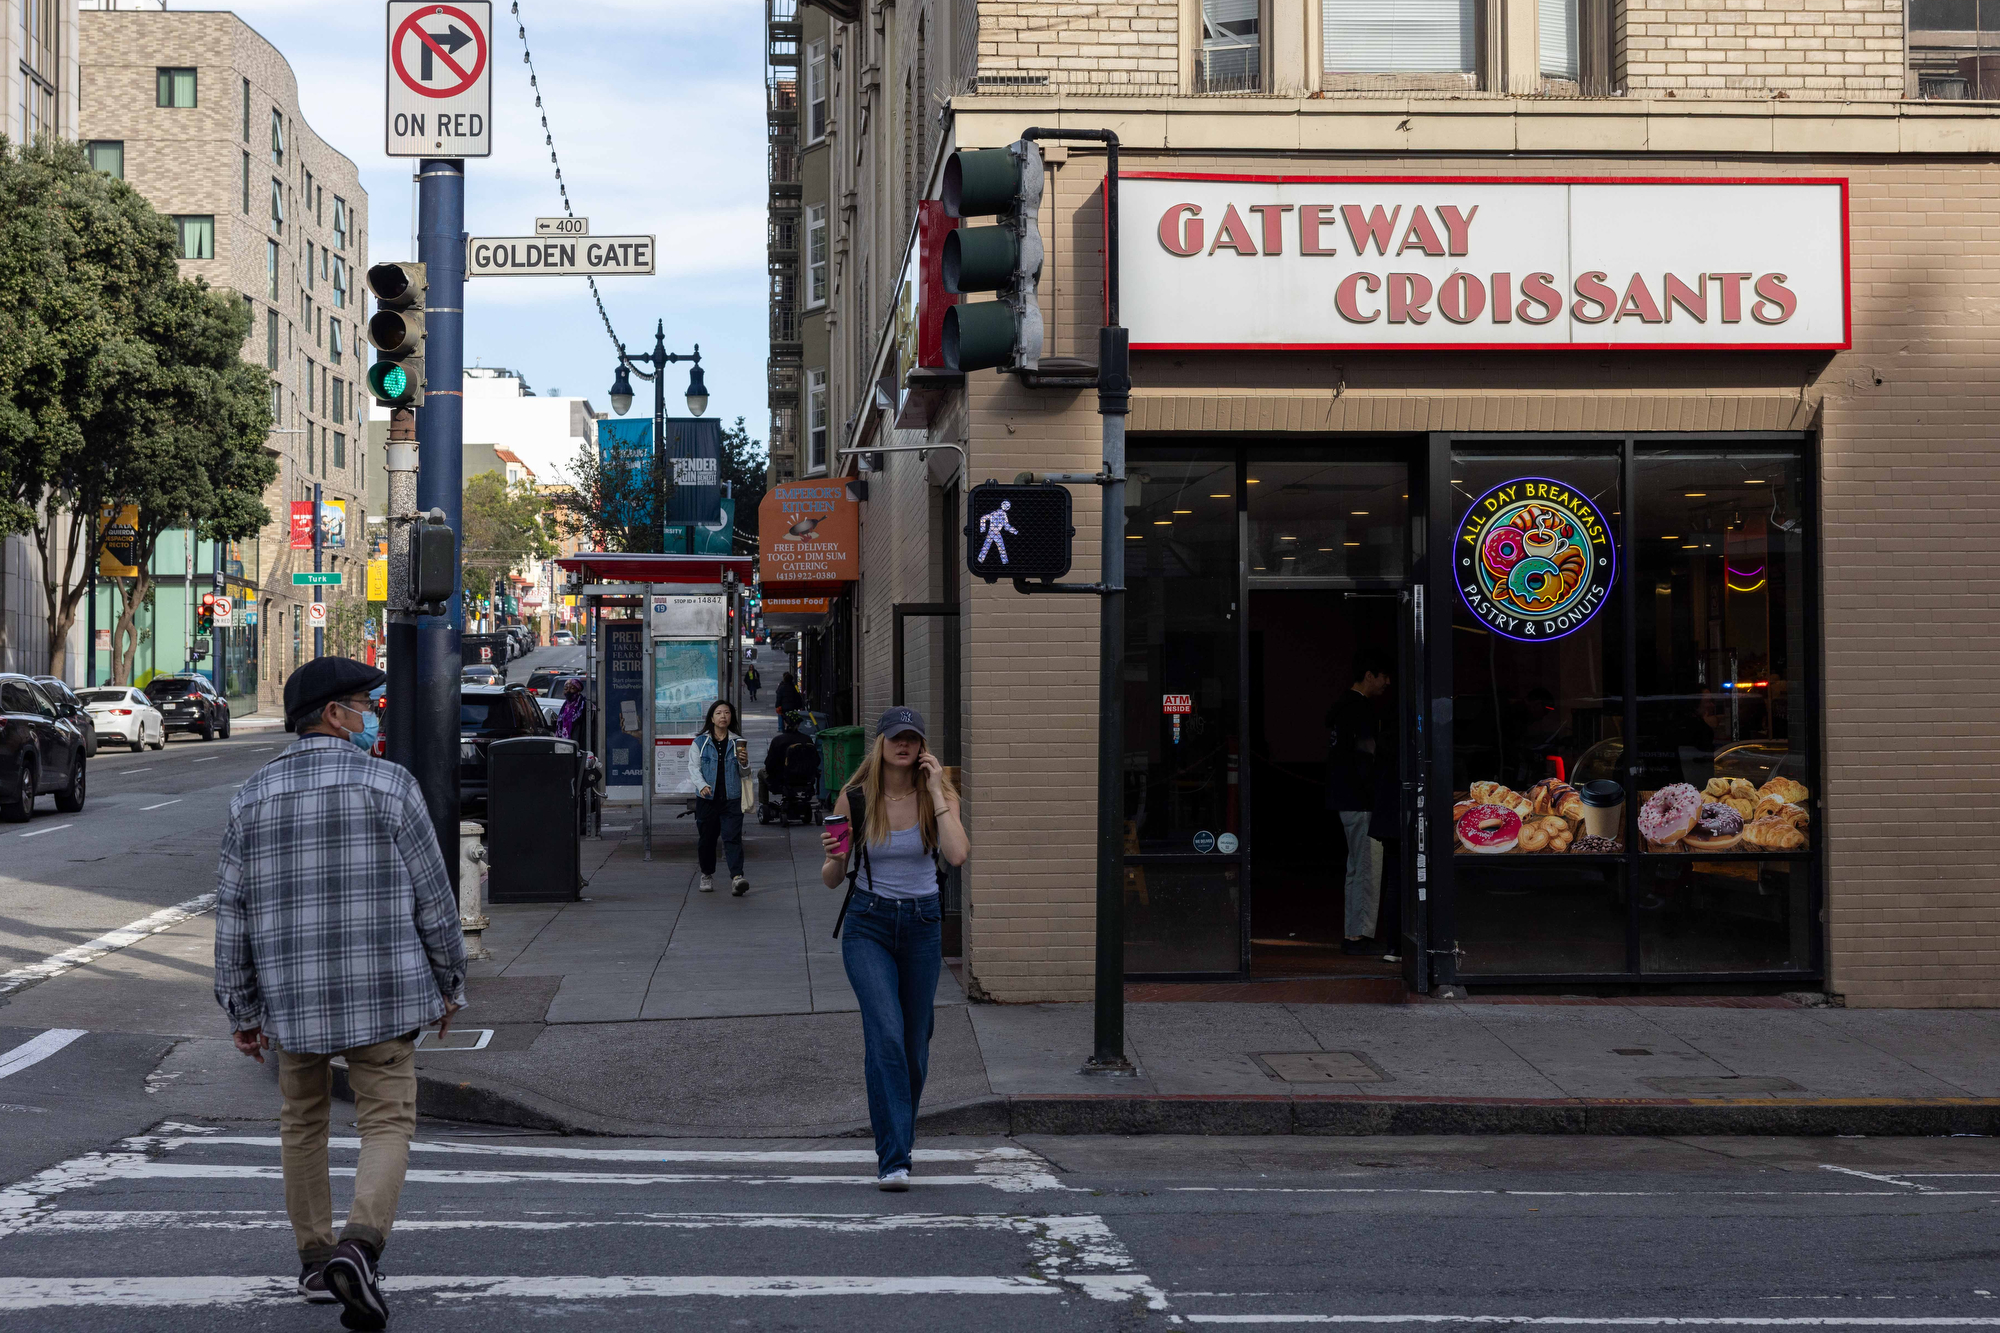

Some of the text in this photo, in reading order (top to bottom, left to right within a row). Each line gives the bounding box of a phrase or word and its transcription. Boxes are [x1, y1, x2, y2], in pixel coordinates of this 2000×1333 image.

[394, 113, 483, 137] ON RED
[556, 219, 582, 233] 400
[1158, 202, 1479, 257] GATEWAY
[474, 243, 651, 268] GOLDEN GATE
[1334, 271, 1798, 325] CROISSANTS
[669, 458, 717, 471] TENDER
[775, 487, 842, 500] EMPEROR'S
[782, 501, 835, 513] KITCHEN
[1462, 483, 1607, 546] ALL DAY BREAKFAST
[774, 542, 838, 552] FREE DELIVERY
[767, 552, 846, 561] TOGO DIM SUM
[783, 562, 828, 570] CATERING
[776, 571, 836, 580] (415) 922-0380
[767, 597, 824, 605] Chinese Food
[1463, 583, 1605, 635] PASTRY & DONUTS
[480, 646, 492, 659] B
[1165, 695, 1190, 705] ATM
